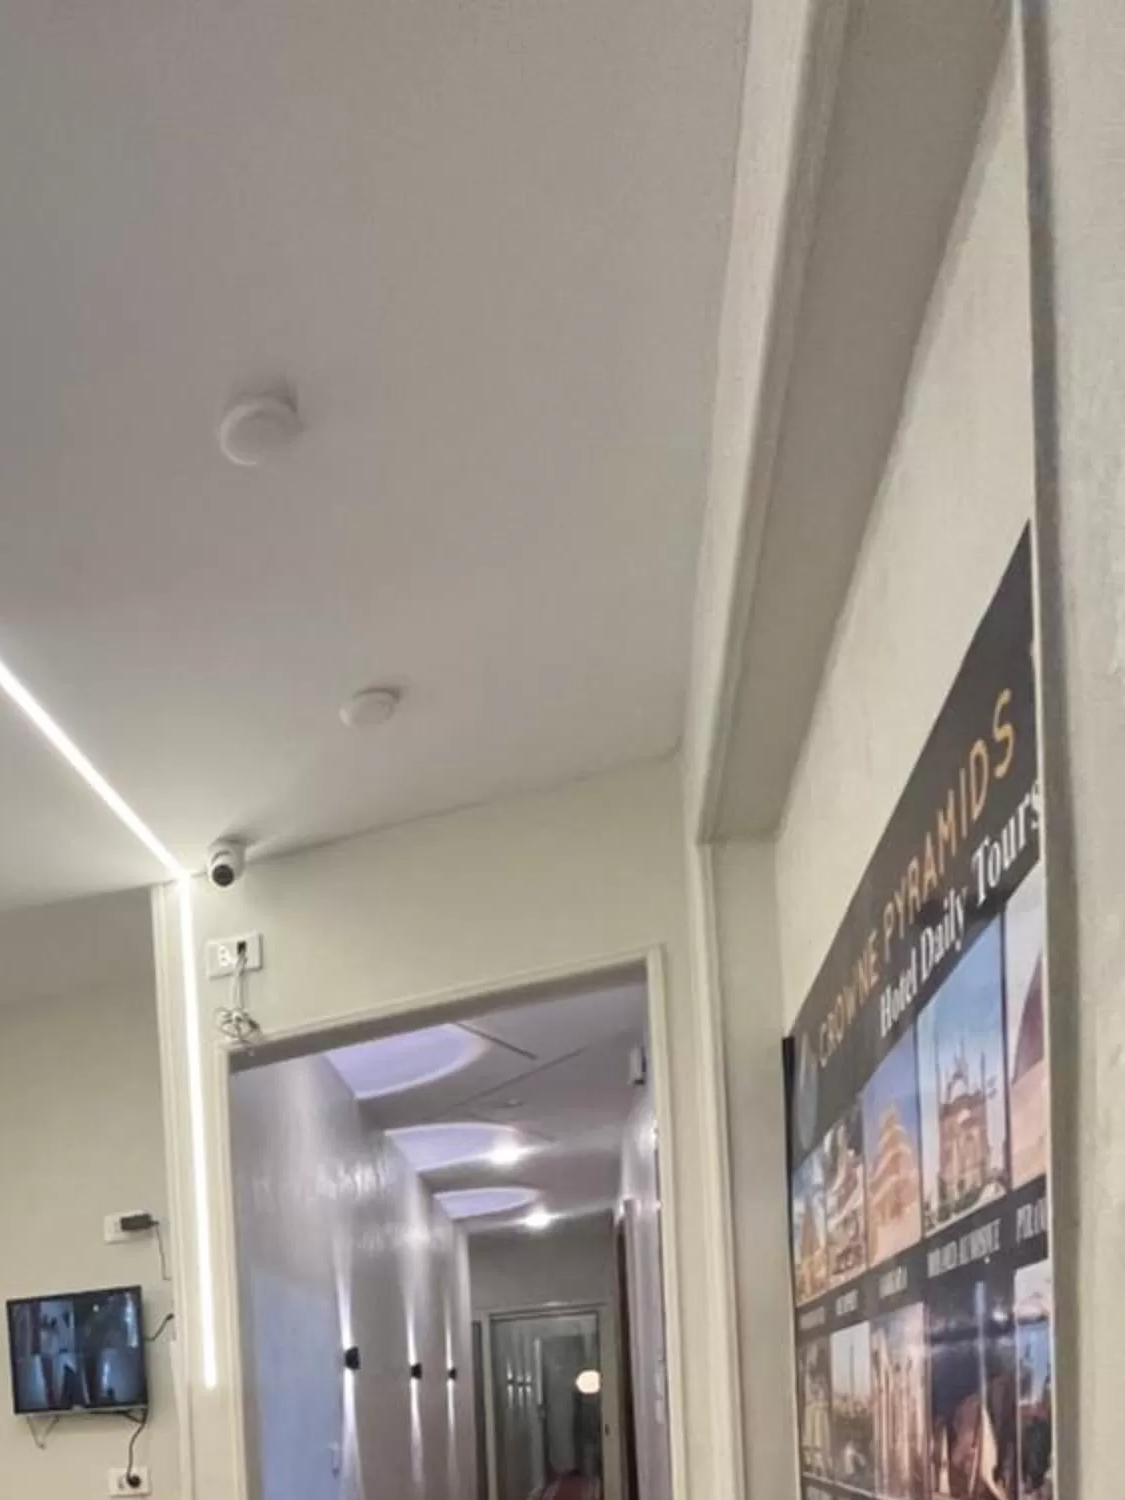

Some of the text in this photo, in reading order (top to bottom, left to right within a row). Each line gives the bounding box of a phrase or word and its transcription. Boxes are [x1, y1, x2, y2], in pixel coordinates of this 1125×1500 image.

[880, 777, 1042, 1038] Hotel Daily Tours
[883, 688, 1014, 963] PYRAMIDS
